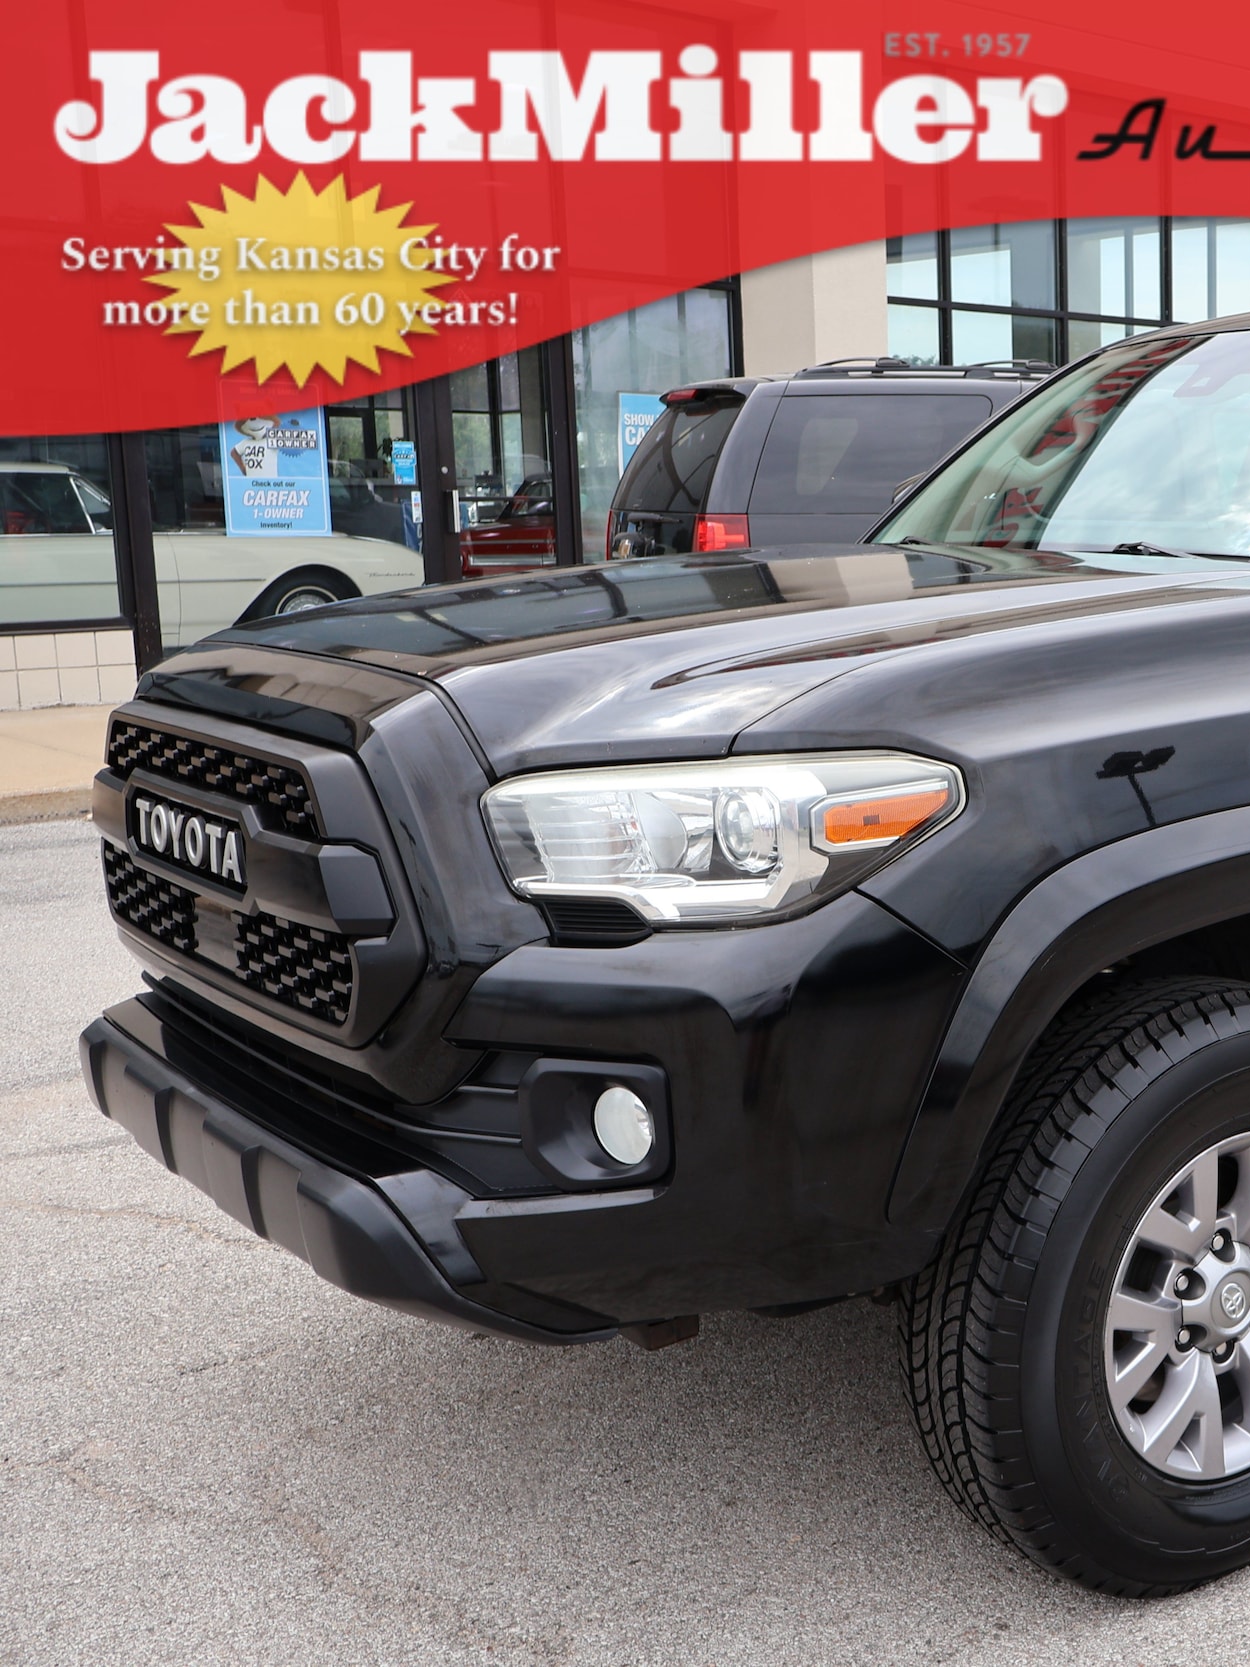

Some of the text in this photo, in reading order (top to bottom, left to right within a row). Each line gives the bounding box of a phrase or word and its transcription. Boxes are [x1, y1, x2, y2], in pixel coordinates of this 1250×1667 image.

[624, 412, 655, 426] SHOW
[268, 430, 317, 440] CARFAX
[245, 446, 265, 458] CAR
[251, 480, 271, 488] Check
[243, 489, 311, 506] CARFAX
[260, 521, 293, 529] Inventory!
[135, 797, 243, 884] TOYOTA
